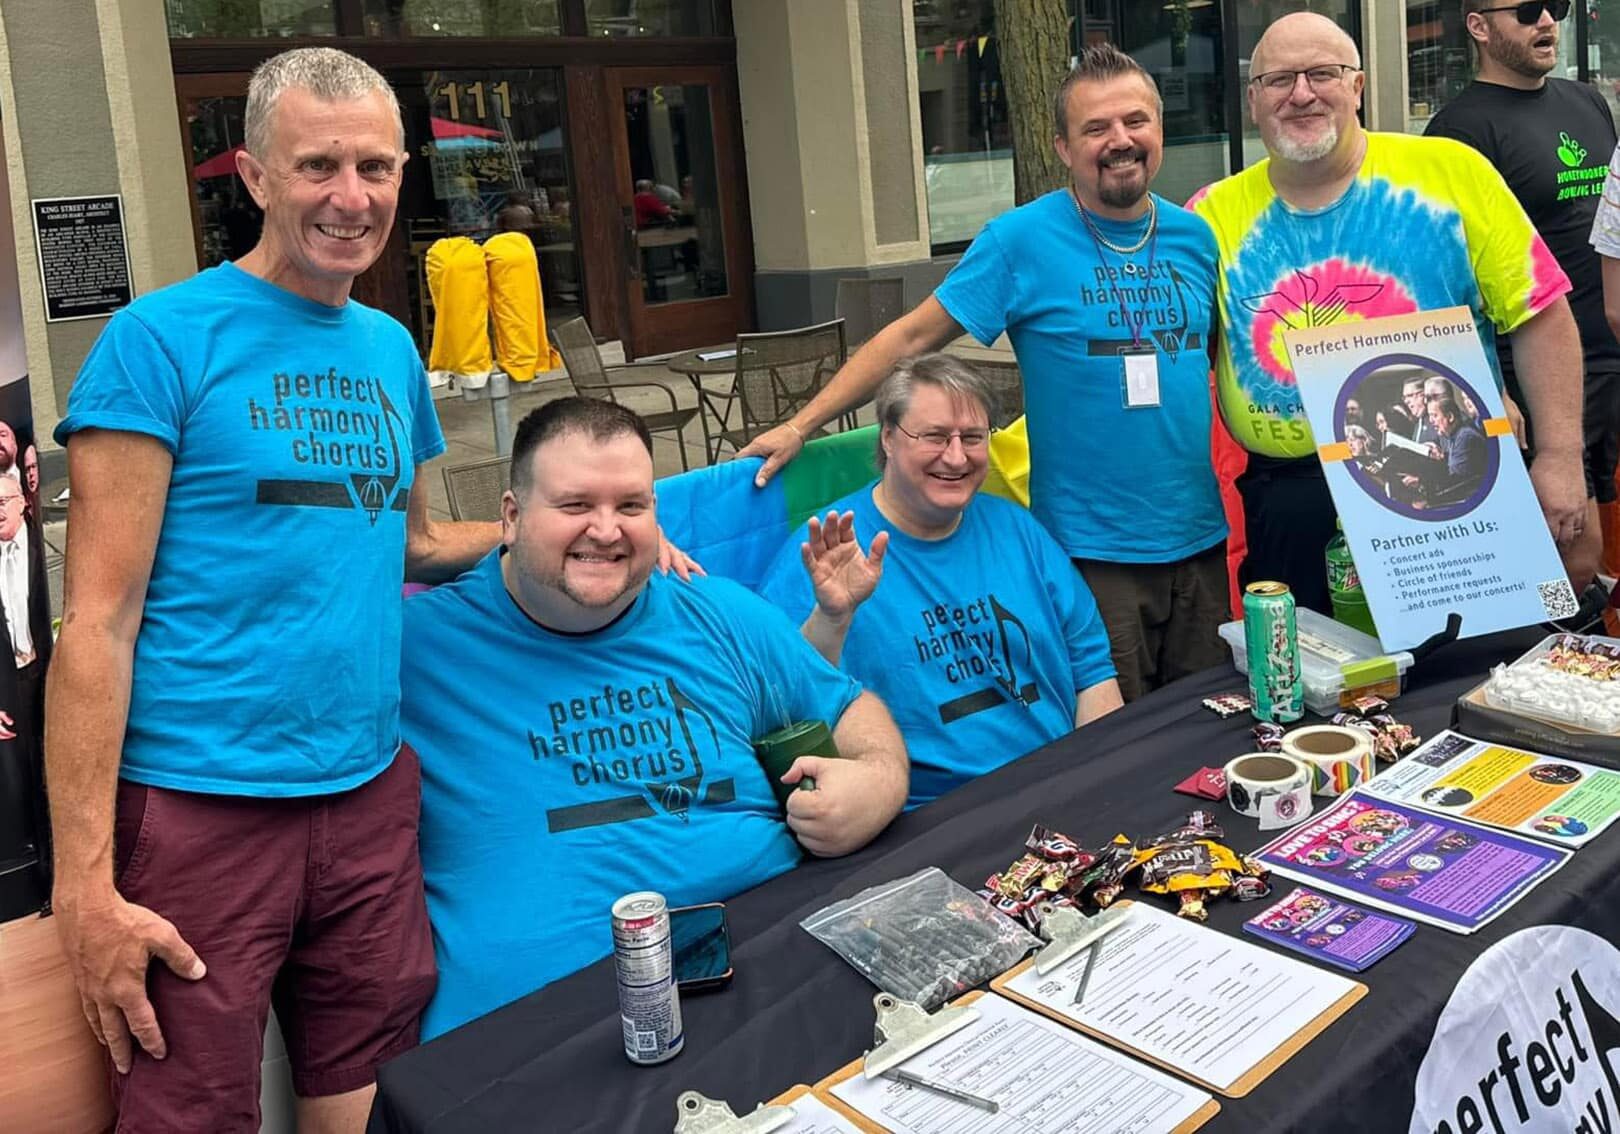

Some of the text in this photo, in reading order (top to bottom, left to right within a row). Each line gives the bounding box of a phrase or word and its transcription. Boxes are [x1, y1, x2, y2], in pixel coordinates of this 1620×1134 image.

[440, 81, 512, 120] 111
[1295, 321, 1472, 357] Perfect Harmony Chorus
[273, 366, 377, 406] perfect
[248, 397, 380, 444] harmony
[1248, 403, 1280, 414] GALA
[292, 432, 388, 469] chorus
[1371, 520, 1499, 552] Partner with Us:
[1390, 548, 1444, 565] Concert ads
[1393, 552, 1496, 577] Business sponsorships
[1398, 568, 1472, 589] Circle of friends
[1401, 575, 1502, 600] Performance requests
[1427, 598, 1451, 608] come
[1454, 594, 1464, 603] to
[1466, 591, 1482, 600] our
[1484, 582, 1526, 597] concerts!
[548, 680, 667, 733] perfect
[527, 715, 673, 760] harmony
[572, 748, 685, 786] chorus
[1274, 832, 1309, 857] LOVE
[1302, 822, 1323, 842] TO
[1434, 988, 1589, 1134] erfect
